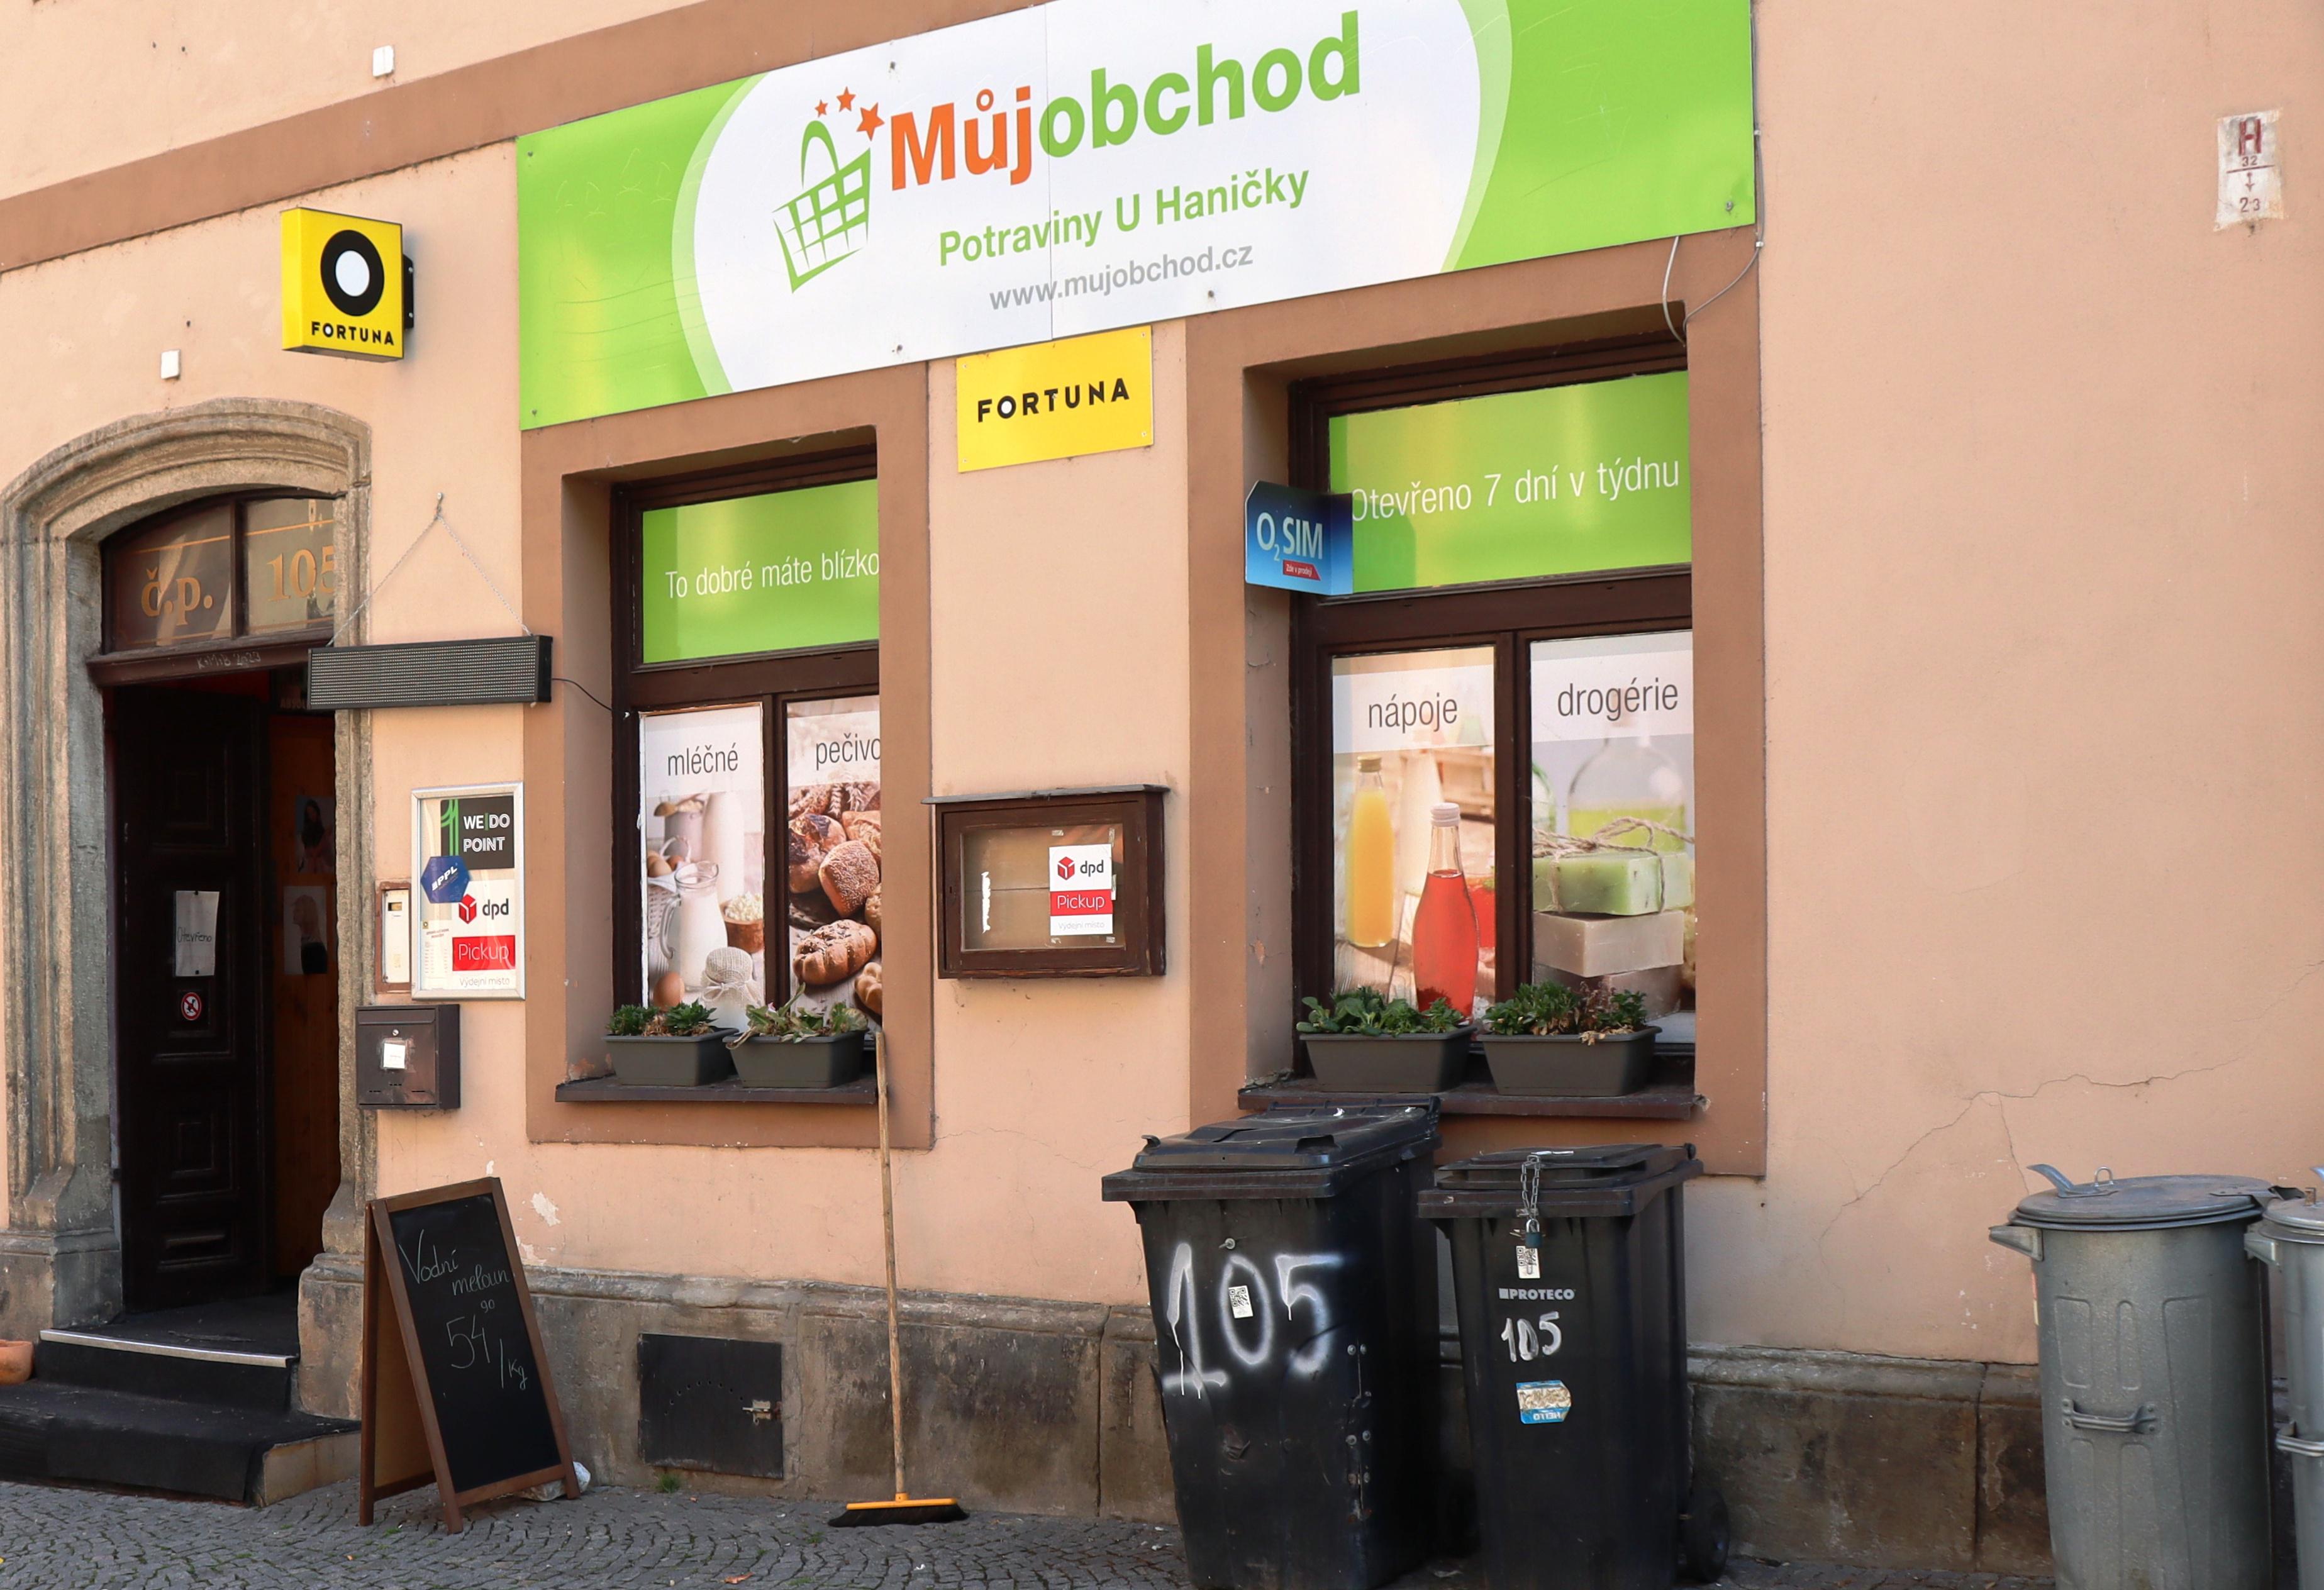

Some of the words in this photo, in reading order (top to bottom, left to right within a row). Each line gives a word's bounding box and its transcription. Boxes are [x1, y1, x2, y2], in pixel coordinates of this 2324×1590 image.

[890, 9, 1361, 191] Můjobchod
[2238, 118, 2262, 156] H
[2242, 155, 2258, 167] 32
[940, 210, 1103, 267] Potraviny
[1116, 193, 1140, 231] U
[1156, 167, 1309, 225] Haničky
[989, 245, 1254, 310] www.mujobchod.cz
[311, 321, 394, 346] FORTUNA
[977, 377, 1130, 423] FORTUNA
[1352, 481, 1472, 522] Otevřeno
[1484, 474, 1502, 507] 7
[1514, 465, 1559, 504] dní
[1570, 470, 1586, 498] v
[1598, 457, 1680, 501] týdnu
[1282, 516, 1323, 560] SIM
[665, 570, 688, 599] To
[696, 560, 753, 595] dobré
[761, 556, 813, 588] máte
[821, 548, 879, 581] blízko
[141, 567, 213, 626] č.p.
[1368, 694, 1458, 734] nápoje
[1557, 677, 1679, 721] drogérie
[668, 742, 738, 777] mléčné
[463, 837, 506, 853] POINT
[437, 866, 459, 886] PPL
[1079, 859, 1104, 877] dpd
[482, 898, 509, 920] dpd
[1057, 893, 1105, 912] Pickup
[458, 942, 509, 962] Pickup
[398, 1228, 459, 1284] Vodní
[452, 1264, 511, 1296] meloun
[446, 1315, 491, 1369] 54
[480, 1299, 495, 1313] 90
[1162, 1242, 1344, 1399] 105
[1501, 1310, 1562, 1363] 105
